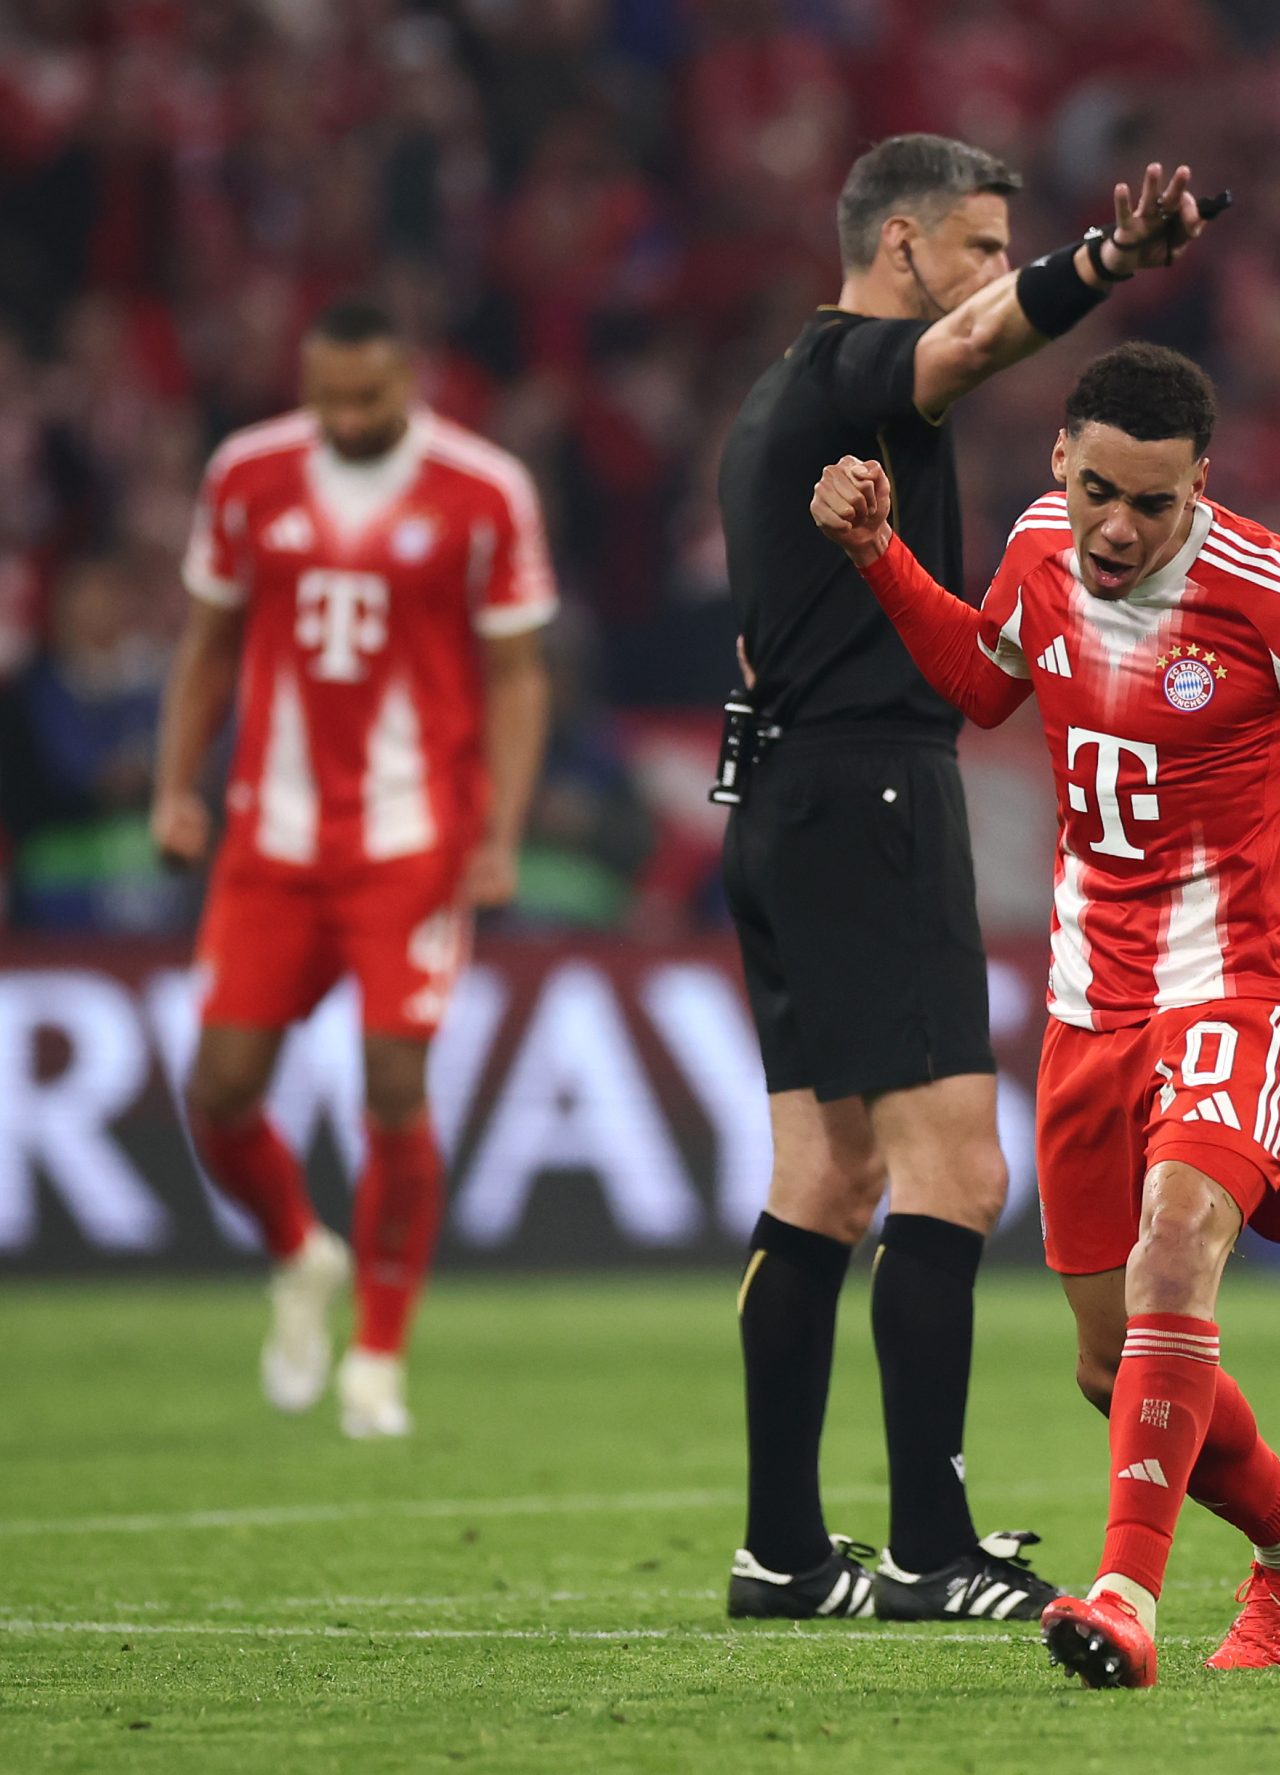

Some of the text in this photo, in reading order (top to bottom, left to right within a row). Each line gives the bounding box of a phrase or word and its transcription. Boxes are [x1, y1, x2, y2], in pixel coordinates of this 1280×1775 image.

[295, 570, 389, 683] T
[1169, 663, 1210, 685] FC BAYERN
[1067, 725, 1160, 861] T
